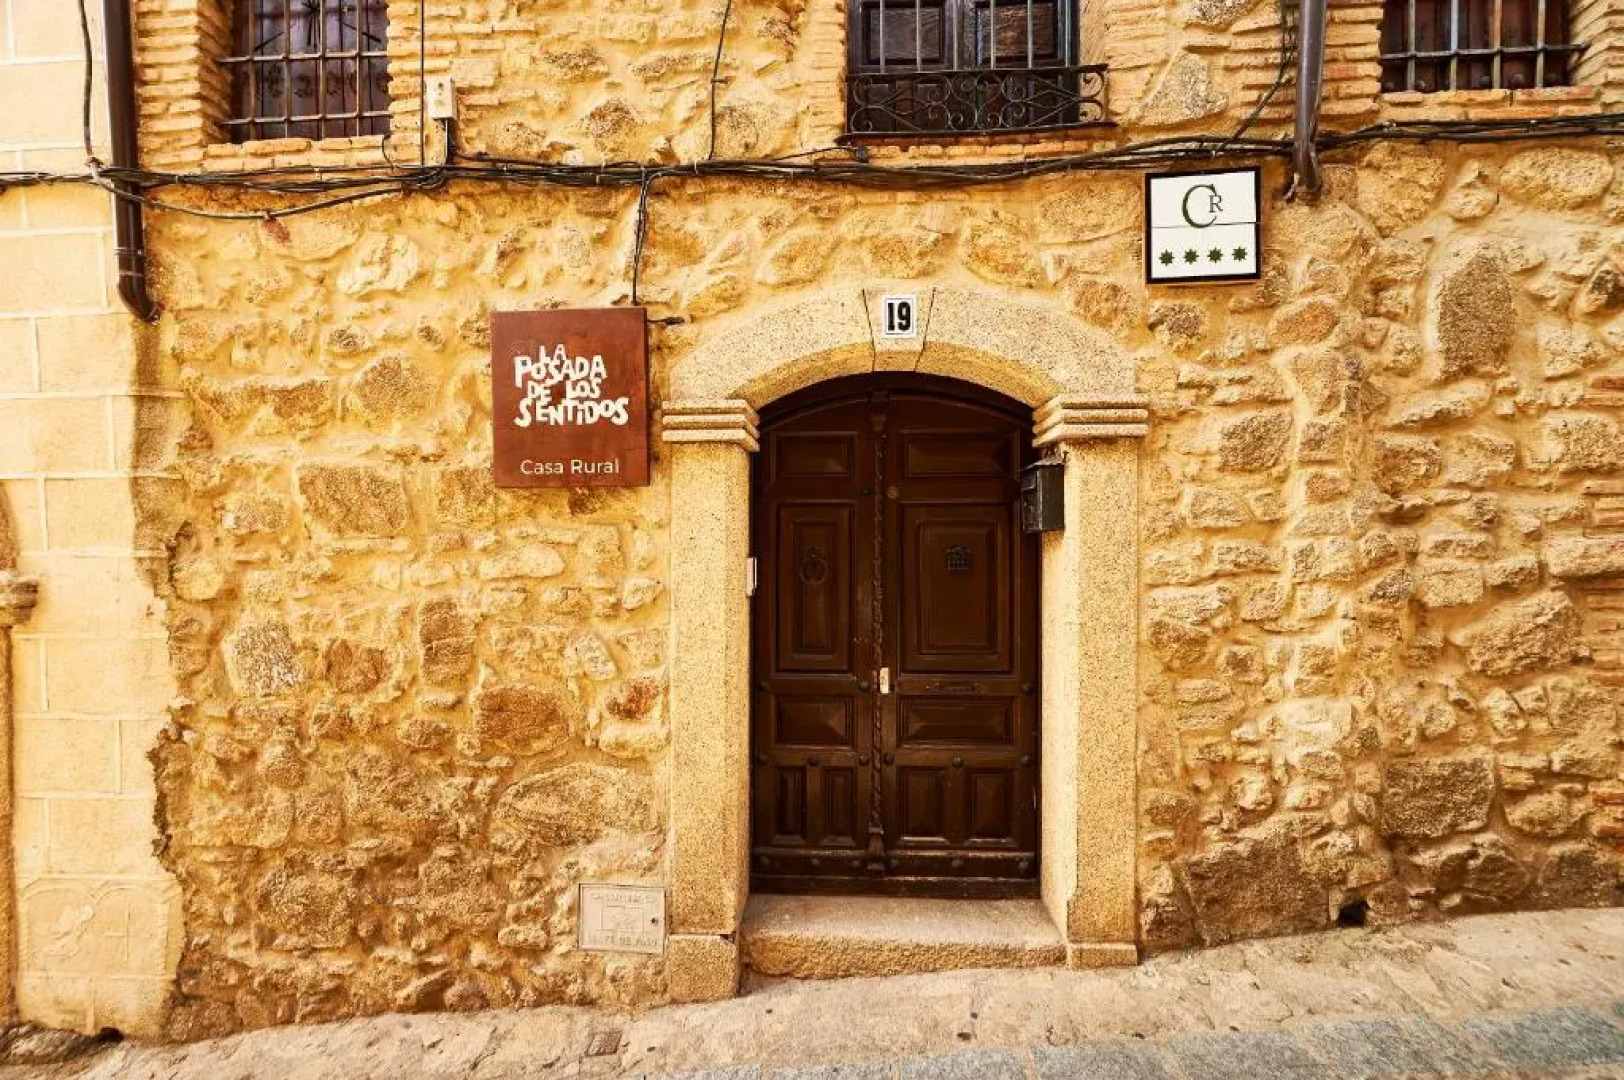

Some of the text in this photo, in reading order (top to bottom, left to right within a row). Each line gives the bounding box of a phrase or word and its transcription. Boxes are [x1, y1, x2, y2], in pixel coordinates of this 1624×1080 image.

[887, 301, 911, 331] 19
[539, 344, 567, 365] LA
[513, 355, 607, 388] POSADA
[527, 379, 602, 402] DE LOS
[520, 458, 620, 474] Casa Rural
